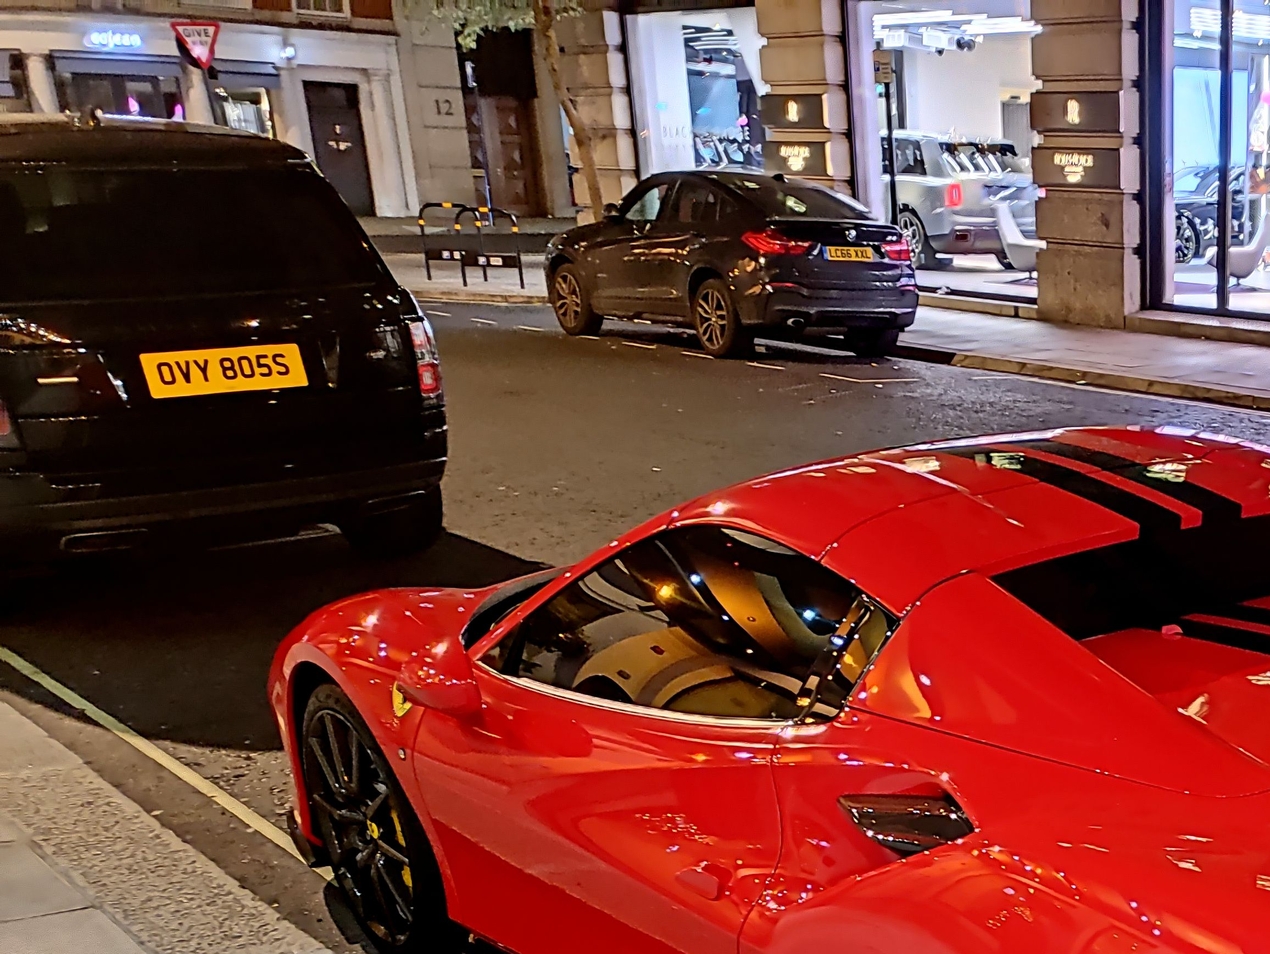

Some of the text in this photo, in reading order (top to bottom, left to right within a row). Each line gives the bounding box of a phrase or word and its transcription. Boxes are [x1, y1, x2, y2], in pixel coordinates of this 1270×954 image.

[182, 28, 211, 38] GIVE
[434, 99, 454, 116] 12
[828, 248, 871, 259] LC66 XXL
[156, 353, 290, 386] OVY 805S
